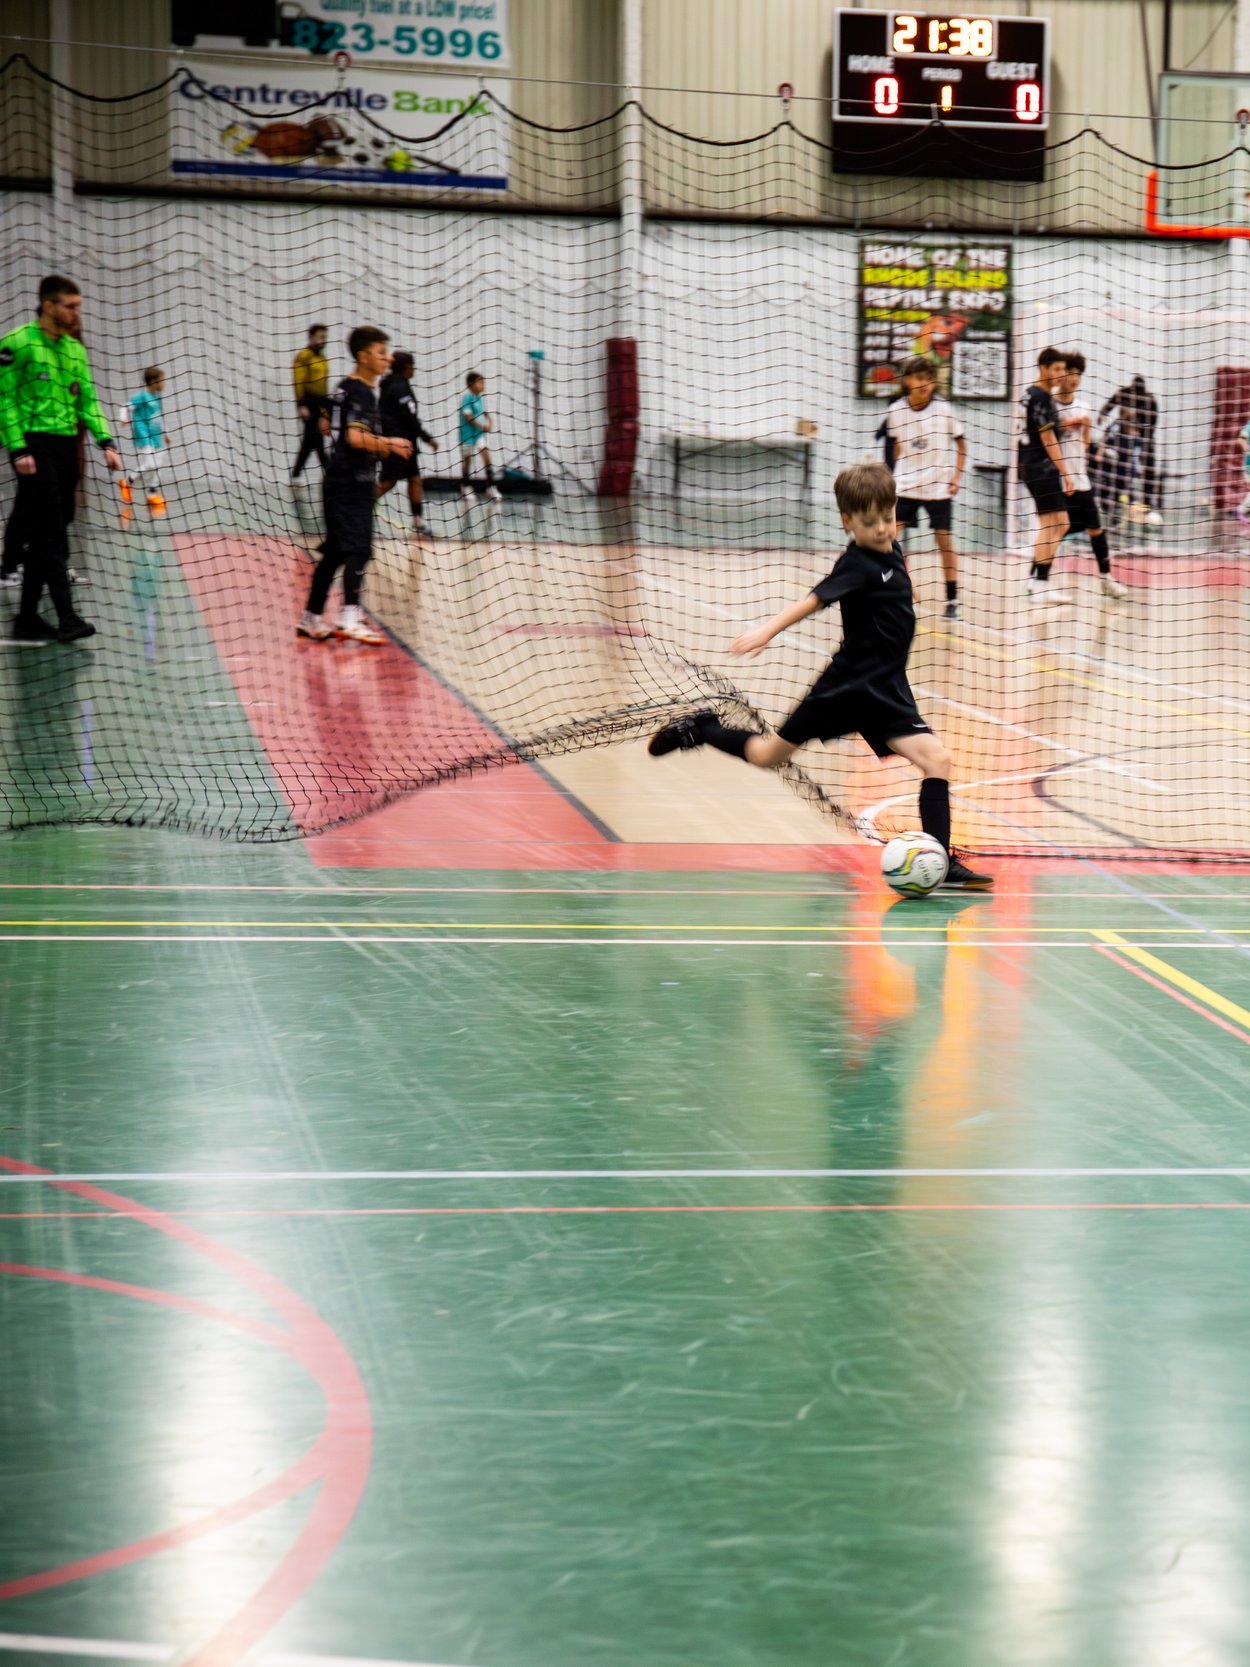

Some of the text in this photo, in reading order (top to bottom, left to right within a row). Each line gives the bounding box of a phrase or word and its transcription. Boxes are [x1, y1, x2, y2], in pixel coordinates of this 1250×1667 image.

[293, 18, 502, 59] 823-5996
[893, 16, 993, 57] 21:38
[848, 54, 1038, 82] HOME PERIOD GUEST
[178, 78, 490, 116] Centreville Bank
[874, 77, 1040, 120] 0 1 0
[864, 245, 1007, 269] HOME OF THE
